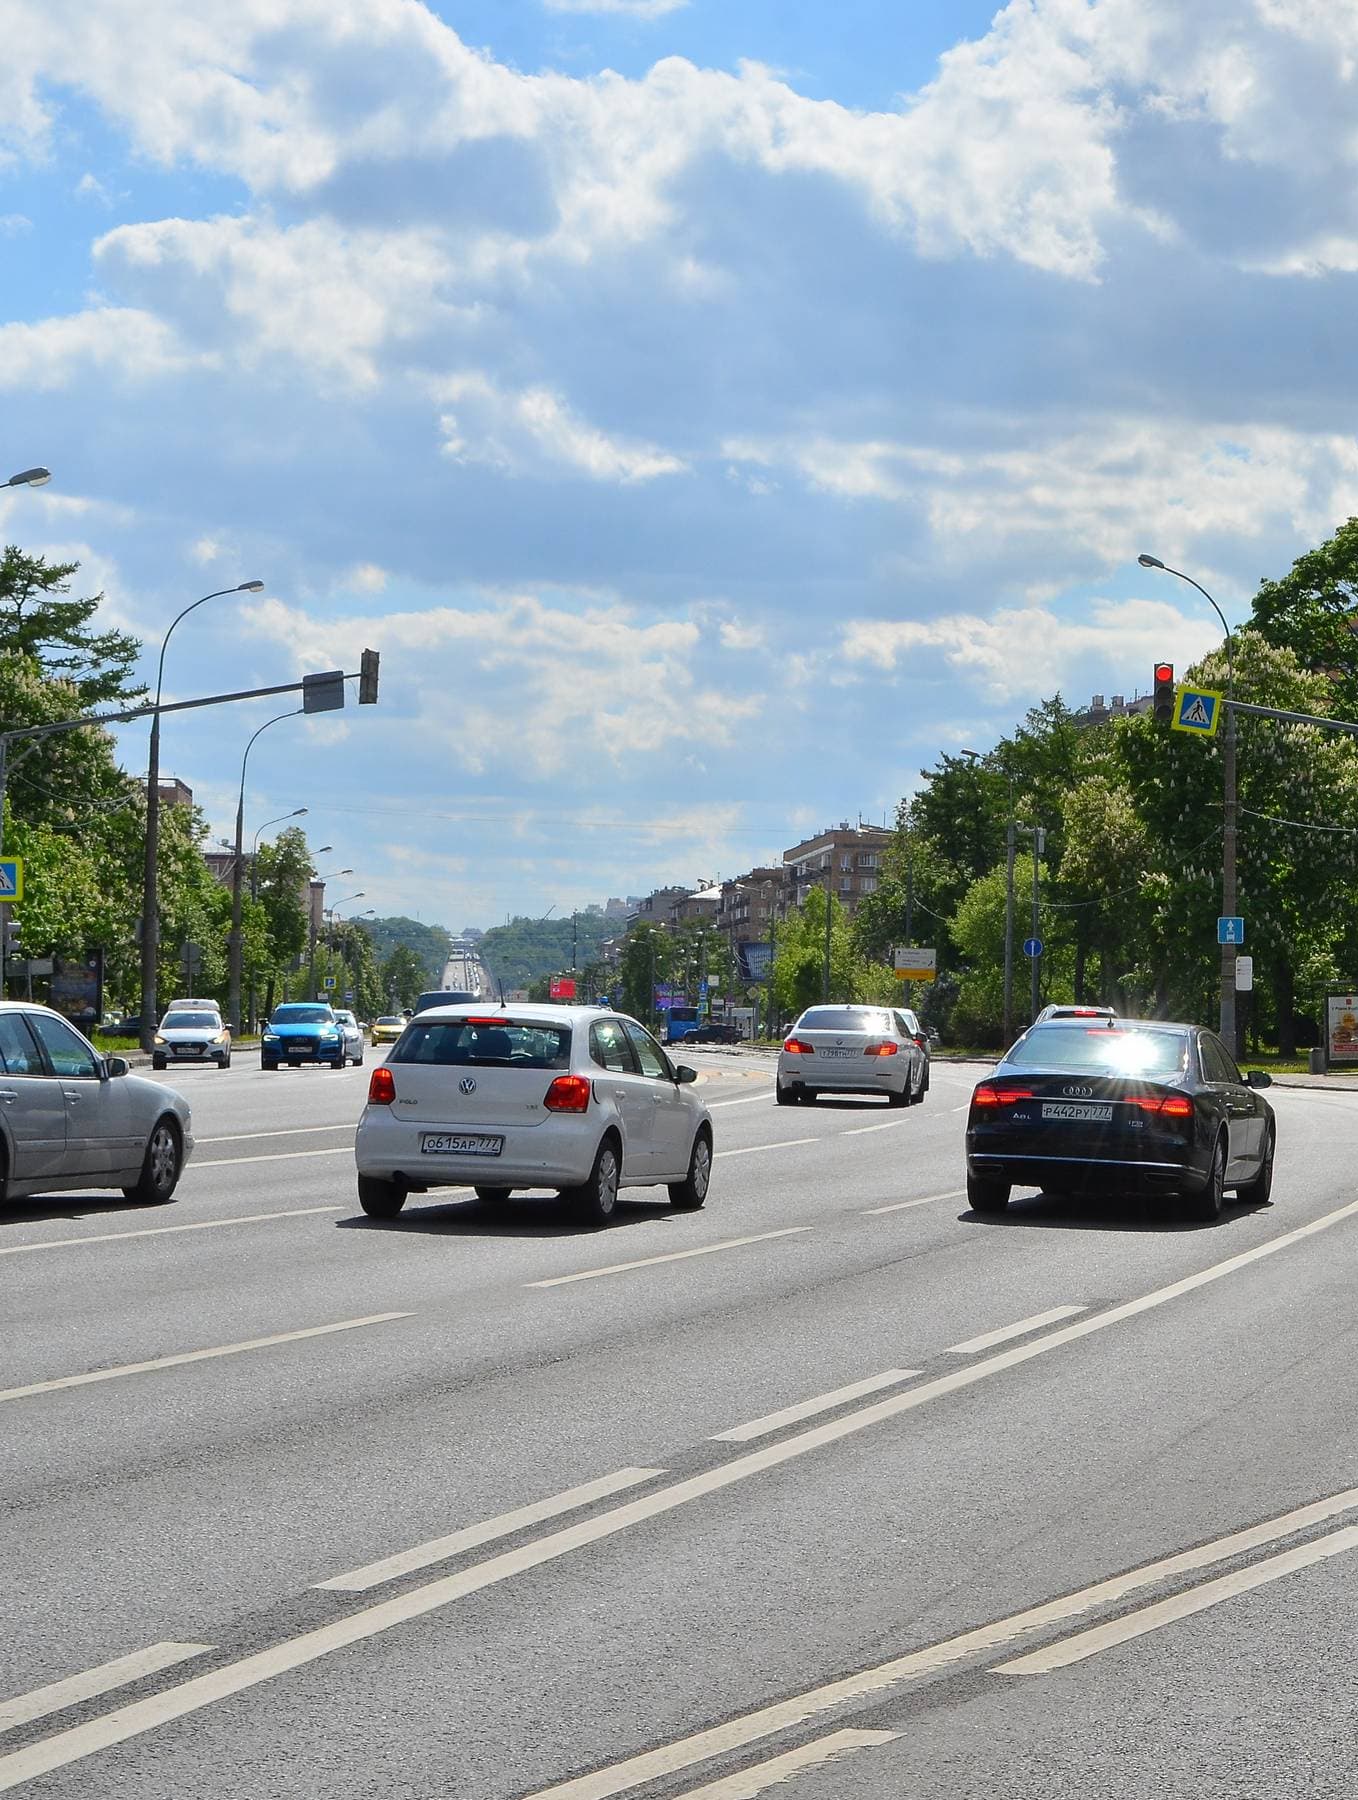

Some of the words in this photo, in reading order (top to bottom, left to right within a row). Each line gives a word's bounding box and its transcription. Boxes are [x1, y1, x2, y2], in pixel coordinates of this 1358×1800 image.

[1045, 1105, 1090, 1118] Р442РУ
[1092, 1106, 1109, 1117] 777
[427, 1137, 476, 1149] О615АР
[479, 1138, 498, 1148] 777
